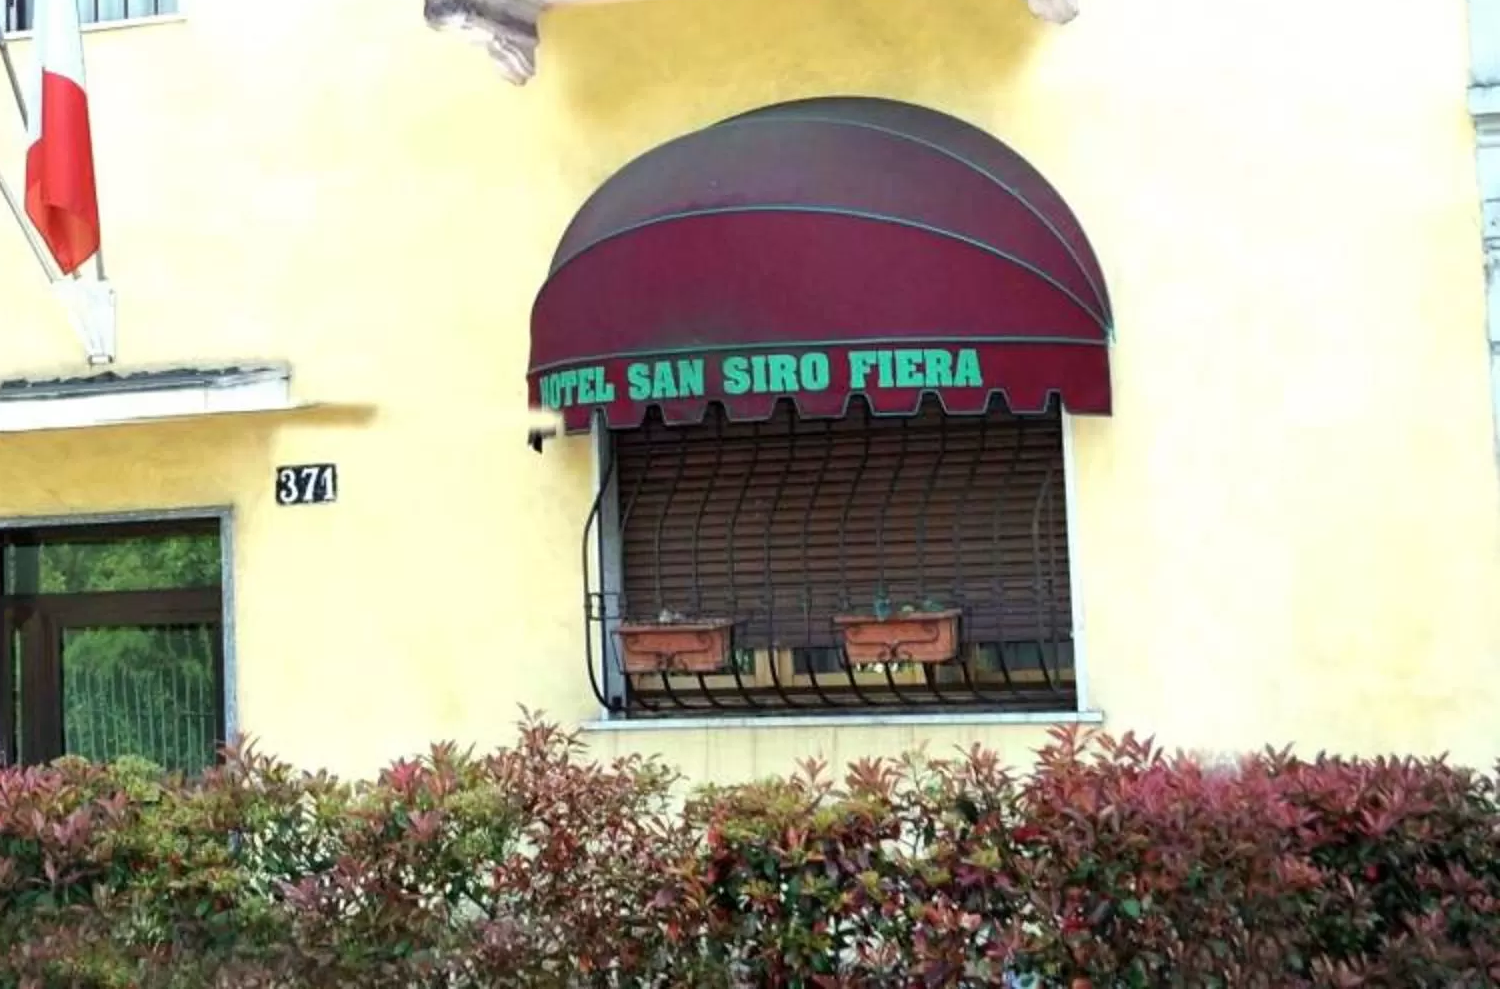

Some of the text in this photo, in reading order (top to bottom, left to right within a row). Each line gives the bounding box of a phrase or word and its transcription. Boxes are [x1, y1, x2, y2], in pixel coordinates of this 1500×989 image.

[540, 348, 983, 411] HOTEL SAN SIRO FIERA
[279, 466, 336, 503] 371
